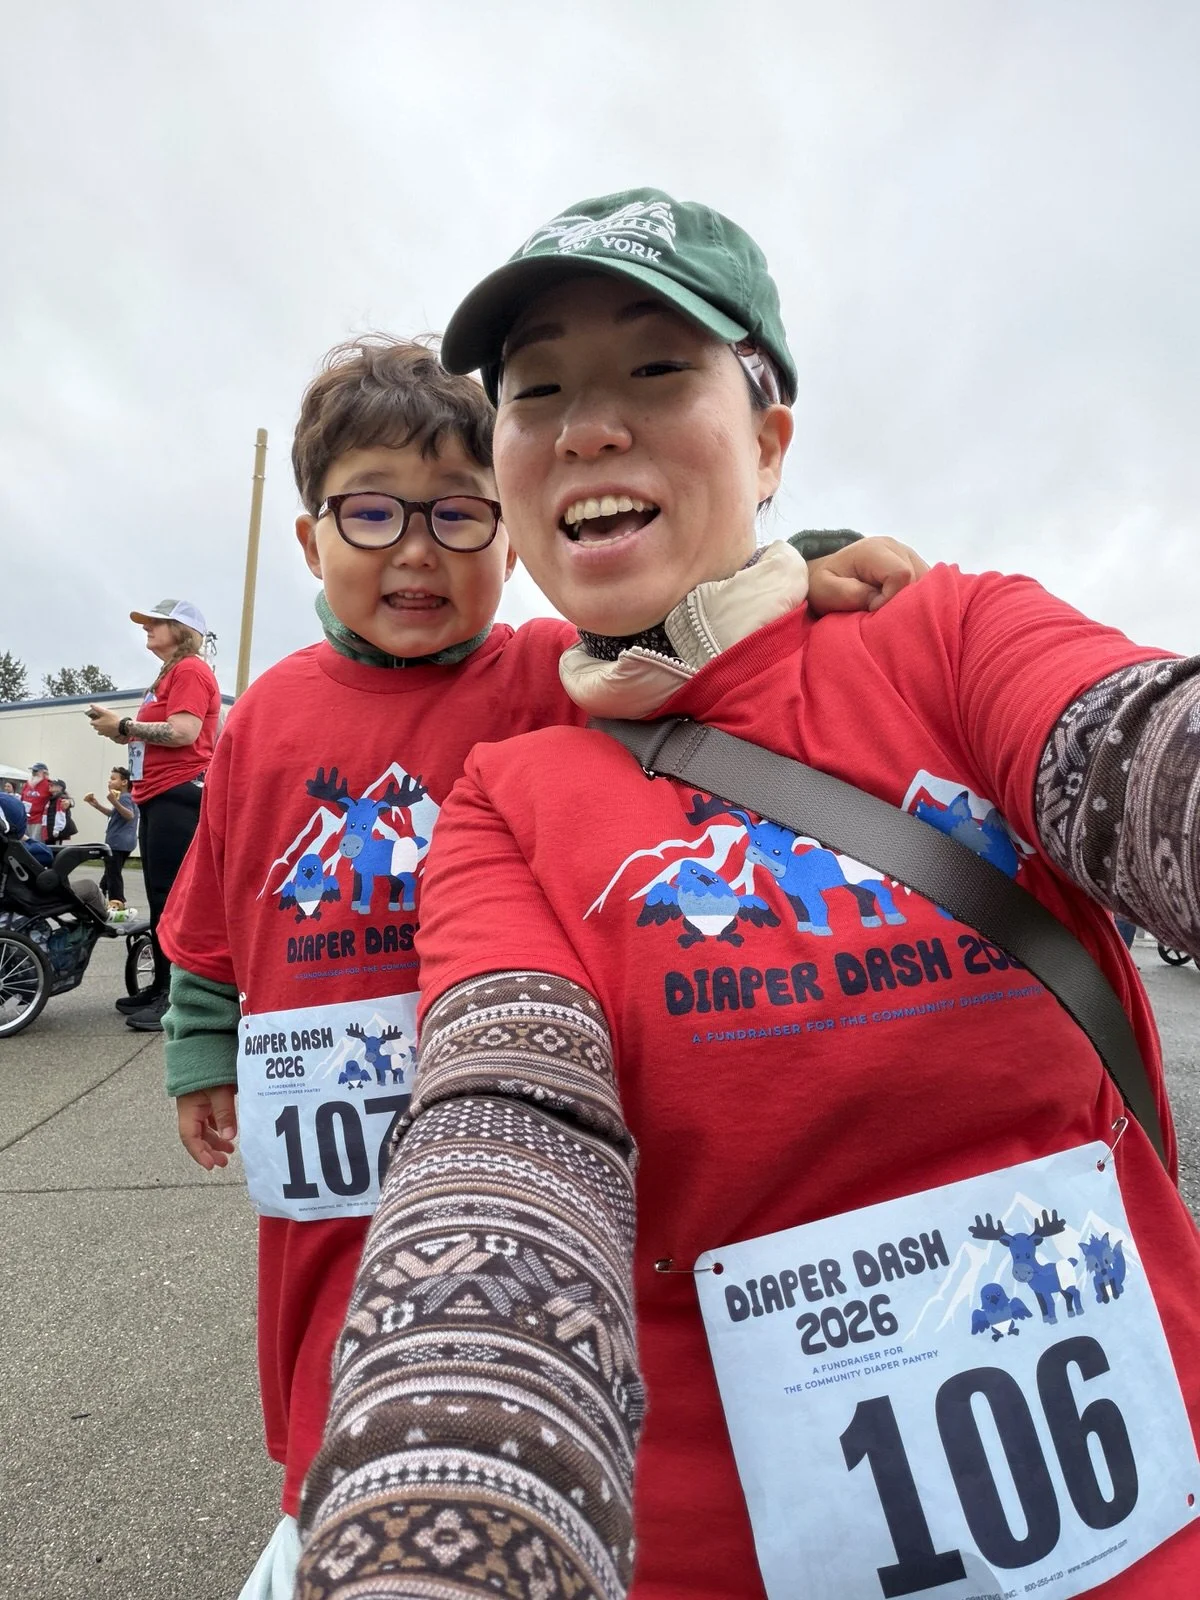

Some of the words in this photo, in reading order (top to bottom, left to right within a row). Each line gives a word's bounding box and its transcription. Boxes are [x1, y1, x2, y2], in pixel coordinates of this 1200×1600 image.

[554, 238, 592, 254] EW
[600, 237, 662, 262] YORK
[287, 929, 356, 963] DIAPER
[345, 967, 360, 975] FOR
[363, 965, 378, 973] THE
[664, 962, 825, 1016] DIAPER
[834, 937, 953, 996] DASH
[957, 935, 1024, 975] 20
[692, 1033, 702, 1044] A
[706, 1023, 802, 1042] FUNDRAISER
[806, 1018, 836, 1032] FOR
[840, 1014, 868, 1028] THE
[871, 999, 955, 1022] COMMUNITY
[959, 990, 1004, 1007] DIAPER
[245, 1032, 287, 1056] DIAPER
[291, 1027, 334, 1052] DASH
[265, 1056, 305, 1079] 2026
[275, 1093, 412, 1199] 107
[724, 1257, 847, 1322] DIAPER
[852, 1229, 950, 1288] DASH
[795, 1293, 899, 1355] 2026
[784, 1383, 802, 1395] THE
[804, 1369, 862, 1390] COMMUNITY
[864, 1359, 900, 1375] DIAPER
[903, 1350, 940, 1366] PANTRY
[812, 1366, 820, 1375] A
[821, 1352, 882, 1373] FUNDRAISER
[884, 1346, 904, 1358] FOR
[839, 1335, 1139, 1599] 106
[1024, 1570, 1064, 1593] 800-255-4120
